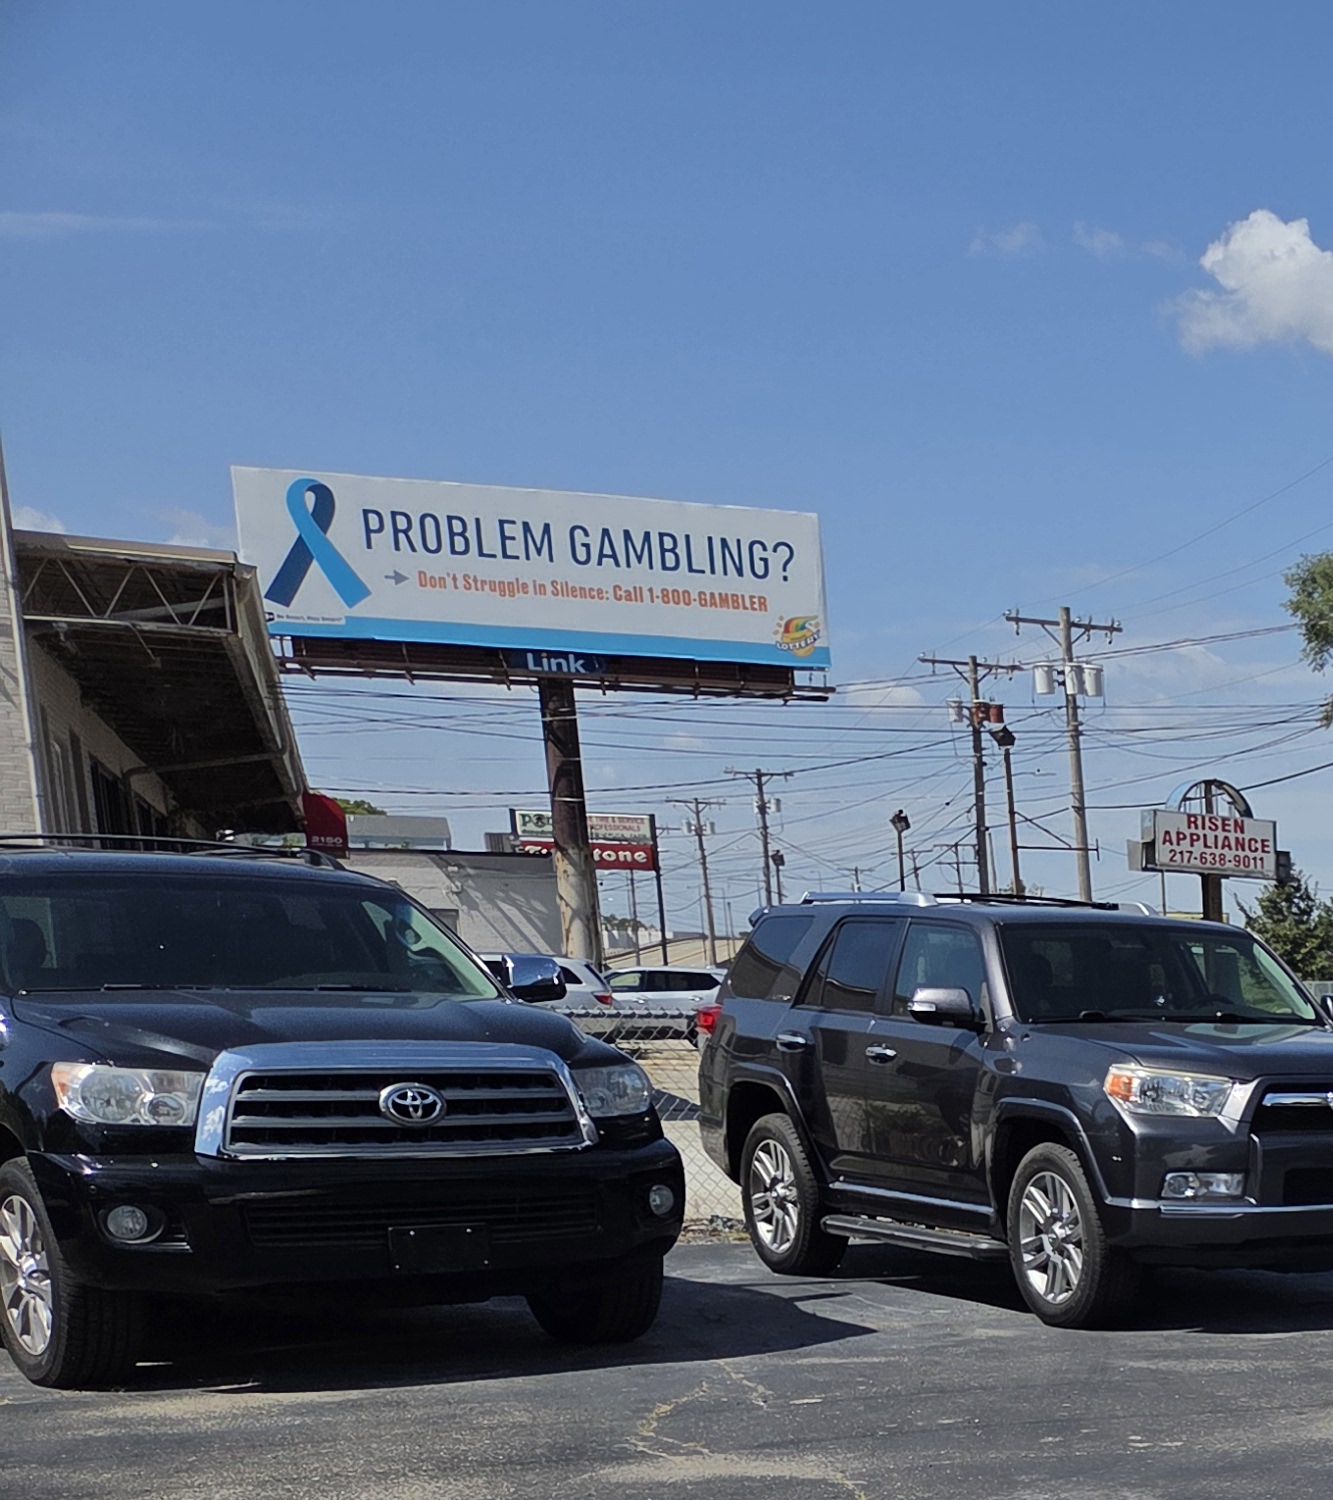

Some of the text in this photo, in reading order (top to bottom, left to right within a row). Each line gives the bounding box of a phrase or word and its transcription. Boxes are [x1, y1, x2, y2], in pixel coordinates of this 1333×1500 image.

[361, 508, 795, 582] PROBLEM GAMBLING?
[417, 569, 770, 613] Don't Struggle in Silence: Call 1-800-GAMBLER
[775, 628, 822, 652] LOTTERY
[526, 652, 588, 674] Link
[1187, 814, 1245, 834] RISEN
[1162, 830, 1271, 854] APPLIANCE
[1168, 848, 1265, 870] 217-638-9011
